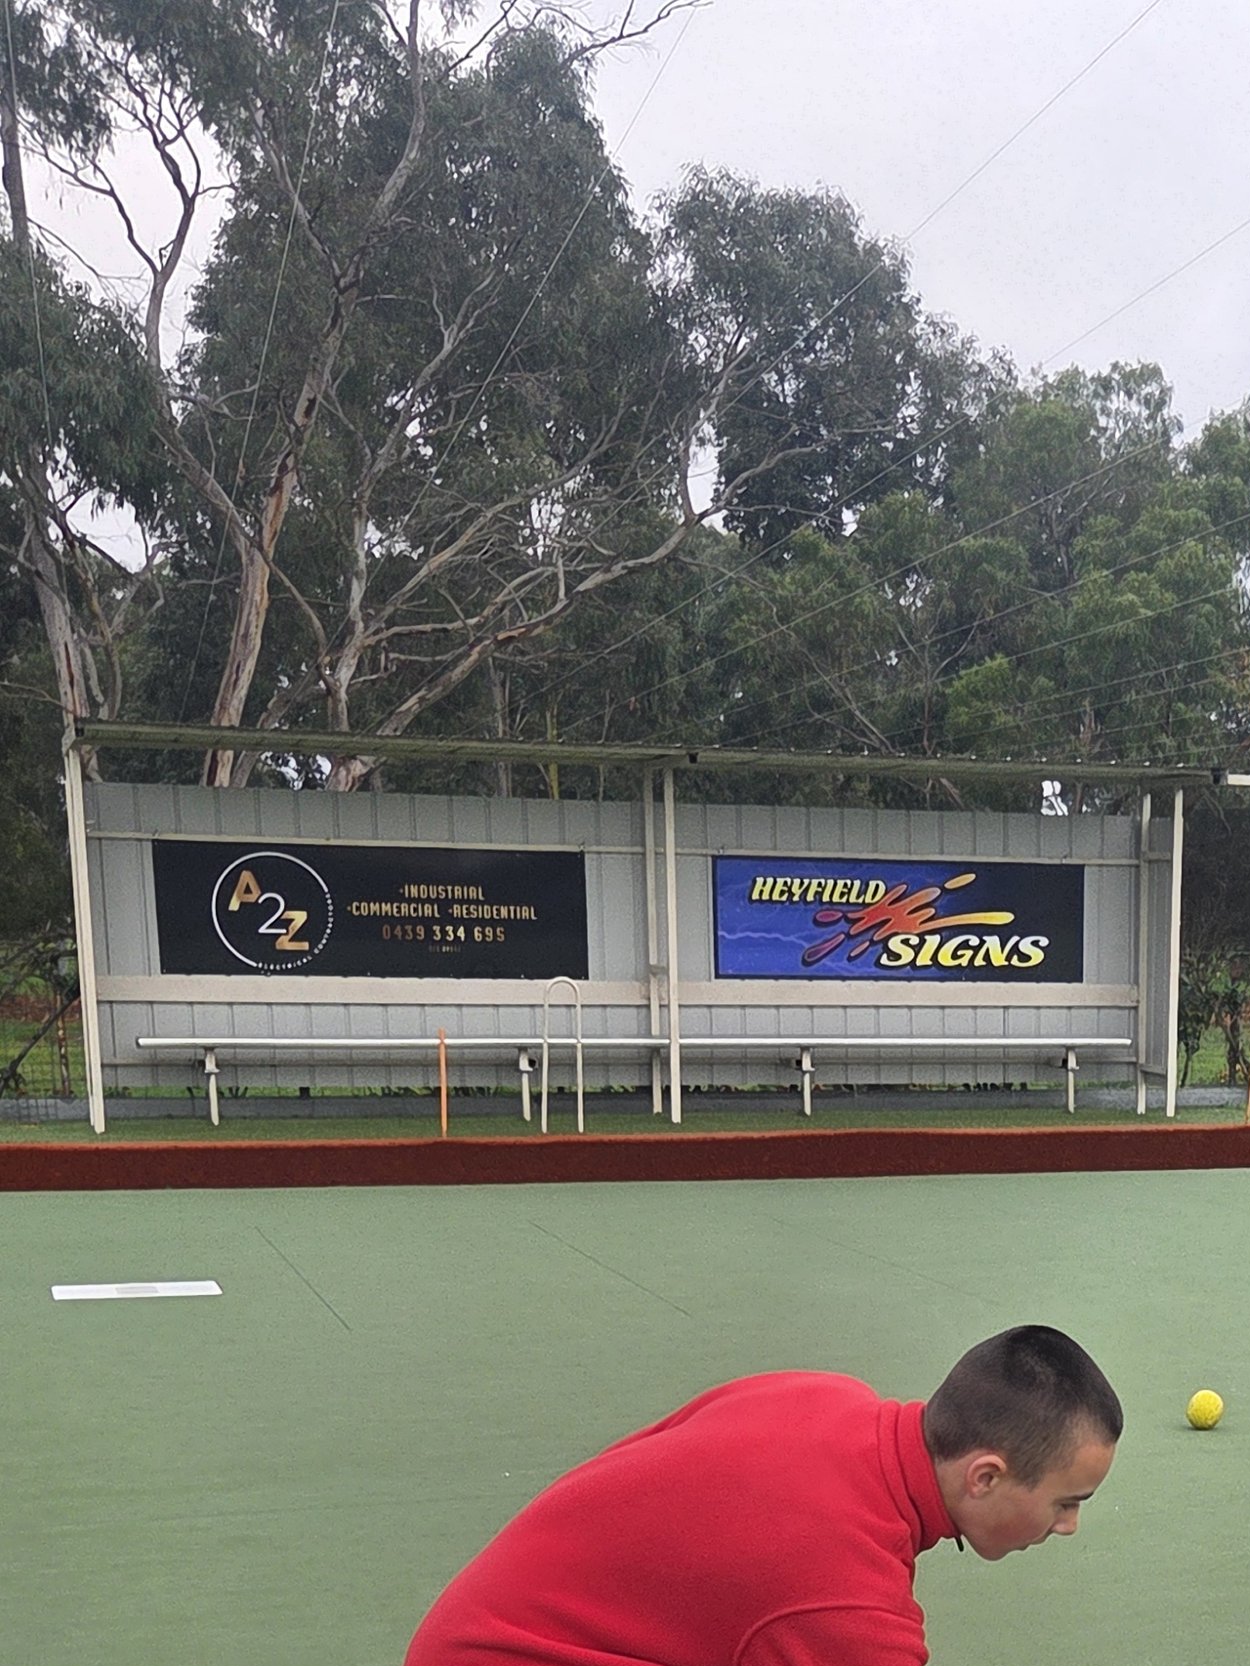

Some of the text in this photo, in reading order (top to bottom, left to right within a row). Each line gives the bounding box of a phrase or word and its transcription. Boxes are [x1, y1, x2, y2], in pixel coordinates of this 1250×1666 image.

[404, 884, 485, 900] INDUSTRIAL
[751, 876, 886, 904] HEYFIELD
[352, 901, 538, 920] COMMERCIAL RESIDENTIAL
[382, 924, 425, 940] 0439
[432, 925, 466, 942] 334
[880, 934, 1050, 968] SIGNS
